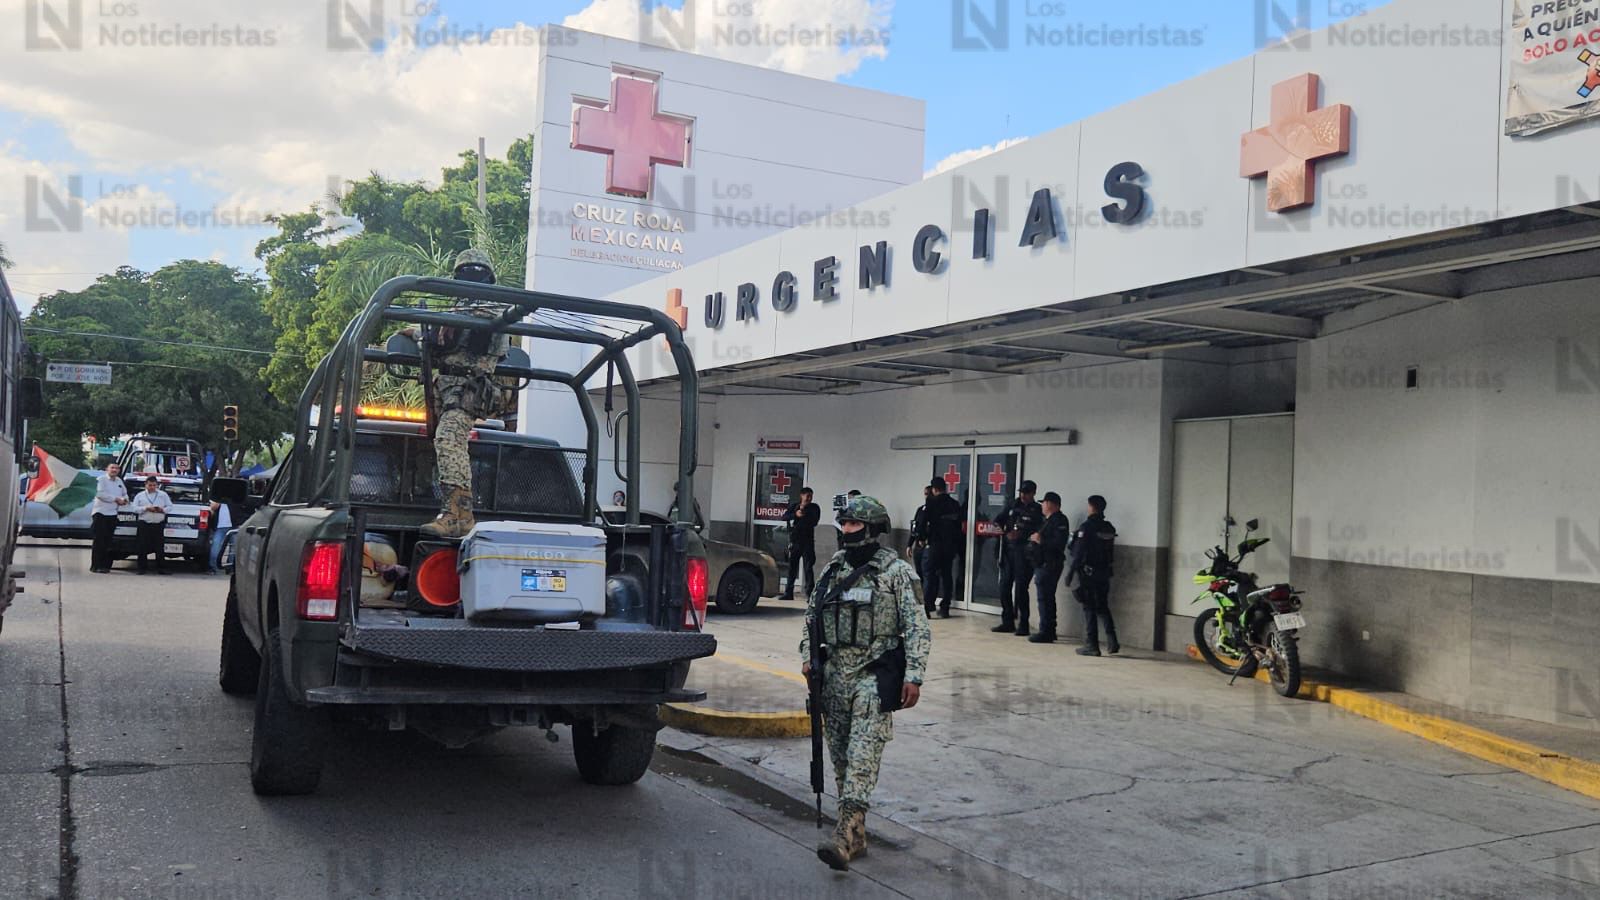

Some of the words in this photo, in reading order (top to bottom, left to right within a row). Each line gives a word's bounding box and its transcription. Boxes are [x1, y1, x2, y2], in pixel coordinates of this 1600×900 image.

[1531, 0, 1592, 18] PREG
[1523, 27, 1534, 42] A
[1537, 8, 1598, 36] QUIÉN
[1523, 38, 1568, 63] SOLO
[573, 202, 627, 225] CRUZ
[633, 210, 684, 233] ROJA
[571, 224, 684, 254] MEXICANA
[705, 161, 1143, 328] URGENCIAS
